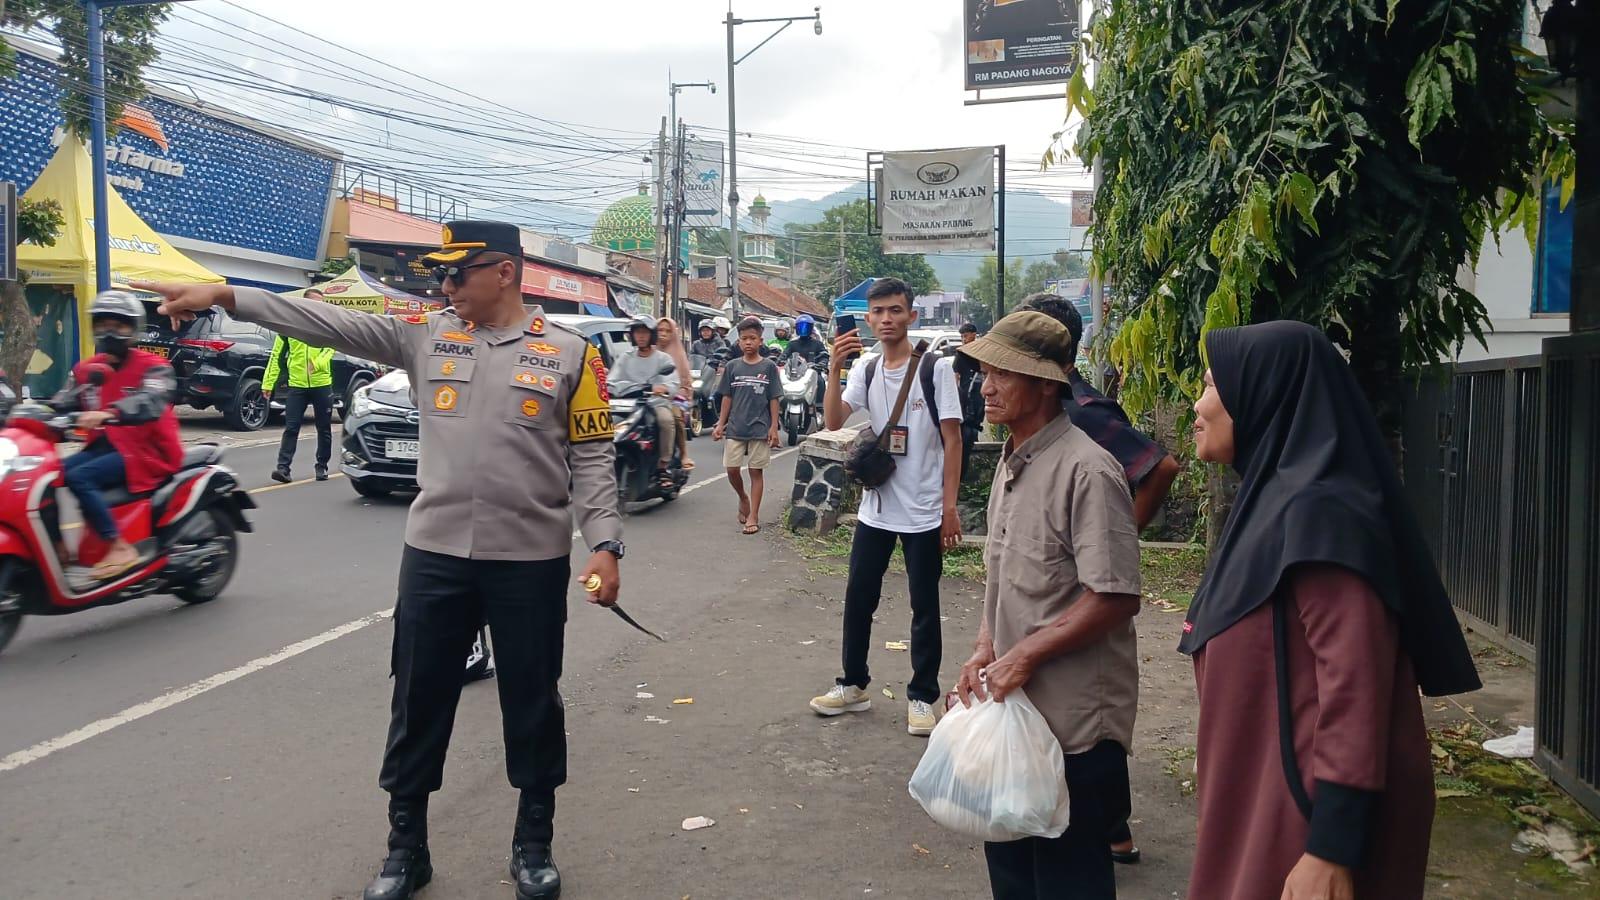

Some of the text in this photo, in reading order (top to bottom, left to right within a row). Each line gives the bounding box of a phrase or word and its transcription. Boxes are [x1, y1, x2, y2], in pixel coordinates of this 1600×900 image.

[975, 65, 1072, 82] RM PADANG NAGOYA
[890, 186, 987, 201] RUMAH MAKAN
[902, 219, 973, 230] MASAKAN PADANG
[434, 343, 474, 356] FARUK
[520, 355, 560, 371] POLRI
[573, 412, 598, 434] KA
